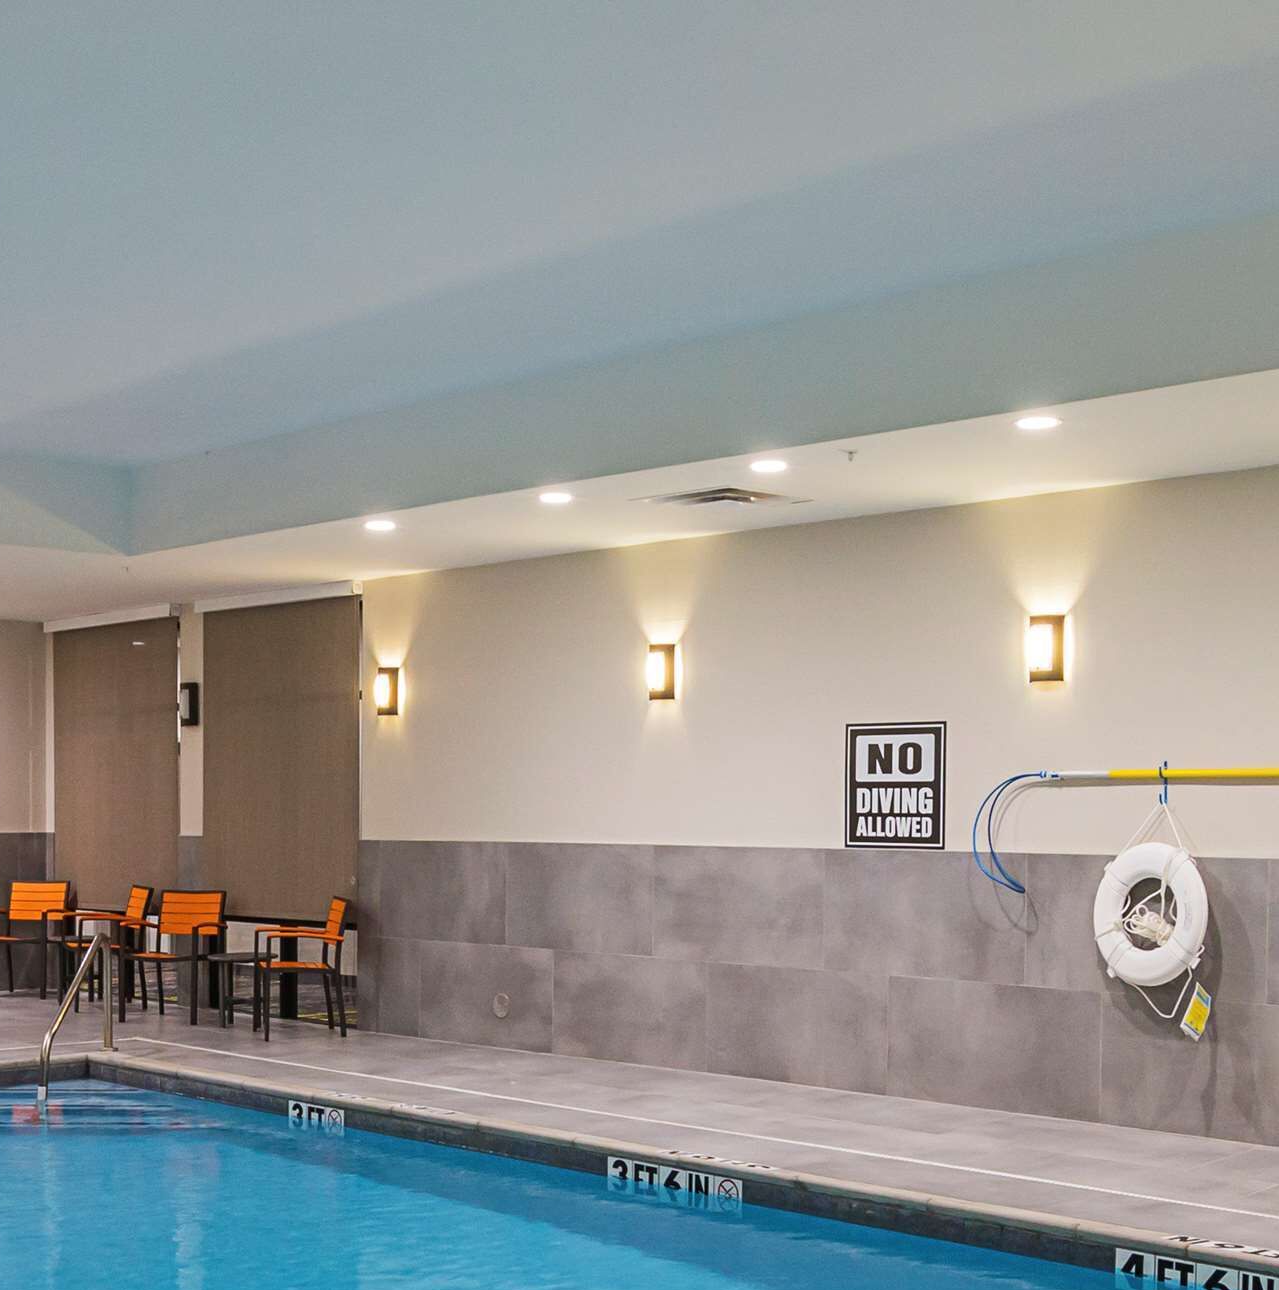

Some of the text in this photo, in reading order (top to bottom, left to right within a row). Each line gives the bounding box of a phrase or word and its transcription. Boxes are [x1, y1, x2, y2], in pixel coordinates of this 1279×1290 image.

[867, 742, 923, 775] NO
[856, 787, 934, 814] DIVING
[856, 816, 933, 839] ALLOWED
[1121, 1253, 1148, 1278] 4
[1157, 1258, 1194, 1287] FT
